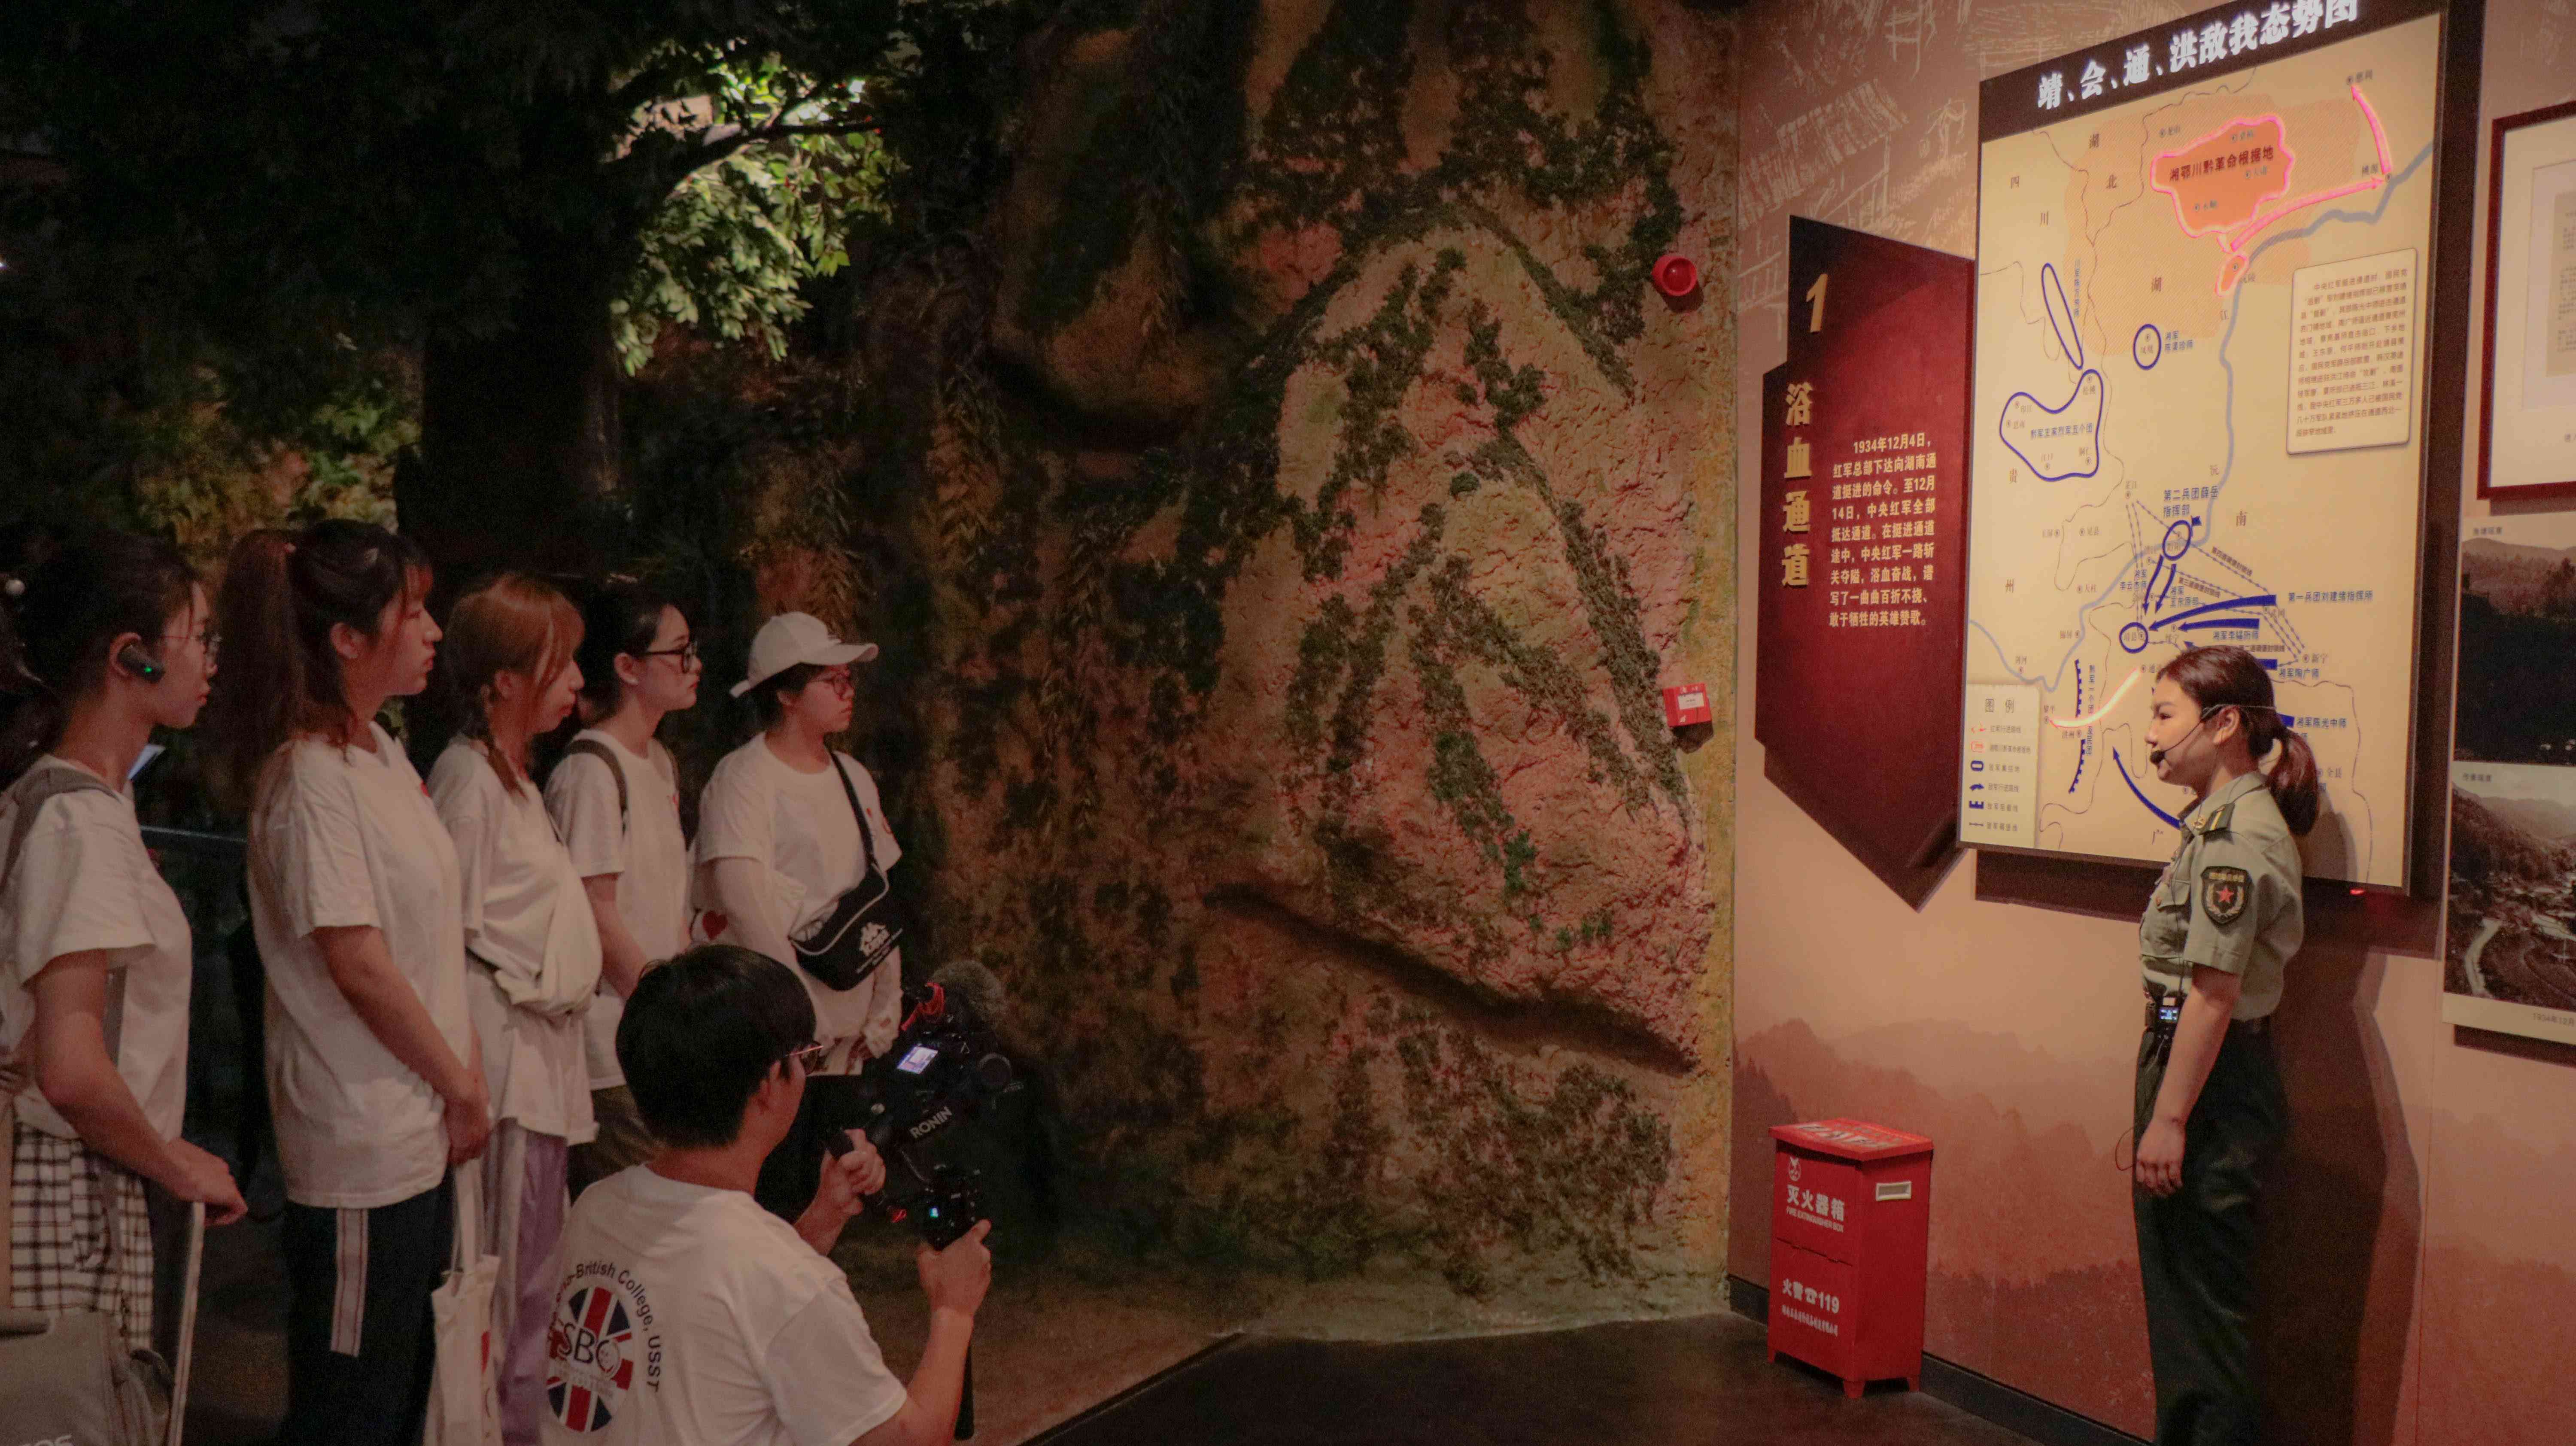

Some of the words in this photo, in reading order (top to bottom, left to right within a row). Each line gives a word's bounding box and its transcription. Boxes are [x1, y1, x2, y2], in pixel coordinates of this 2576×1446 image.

[2037, 0, 2358, 110] 靖、会、通、洪敌我态势图
[2169, 145, 2274, 182] 湘鄂川黔革命根据地
[2011, 176, 2020, 189] 四
[2106, 175, 2118, 189] 北
[2040, 209, 2049, 226] 川
[1806, 273, 1829, 333] 1
[1853, 432, 1931, 454] 1934年12月4日，
[1832, 452, 1937, 478] 红军总部下达向湖南通
[1782, 381, 1813, 587] 浴血通道
[1832, 474, 1935, 500] 道挺进的命令。至12月
[2163, 485, 2219, 502] 第二兵团薛岳
[1832, 497, 1936, 520] 14日，中央红军全部
[2163, 504, 2190, 518] 指挥部
[2236, 510, 2248, 528] 南
[1831, 519, 1935, 543] 抵达通道。在挺进通道
[1830, 542, 1935, 564] 途中，中央红军一路斩
[1830, 564, 1934, 585] 关夺隘，浴血奋战，谱
[1829, 587, 1927, 606] 写了一曲曲百折不挠、
[2005, 579, 2014, 593] 州
[2288, 590, 2374, 602] 第一兵团刘建绪指挥所
[1829, 609, 1926, 627] 敢于牺牲的英雄赞歌。
[1985, 698, 2014, 714] 图例
[909, 1106, 953, 1139] RONIN
[1786, 1184, 1845, 1222] 灭火器箱
[618, 1269, 654, 1332] College,
[647, 1334, 662, 1393] USST
